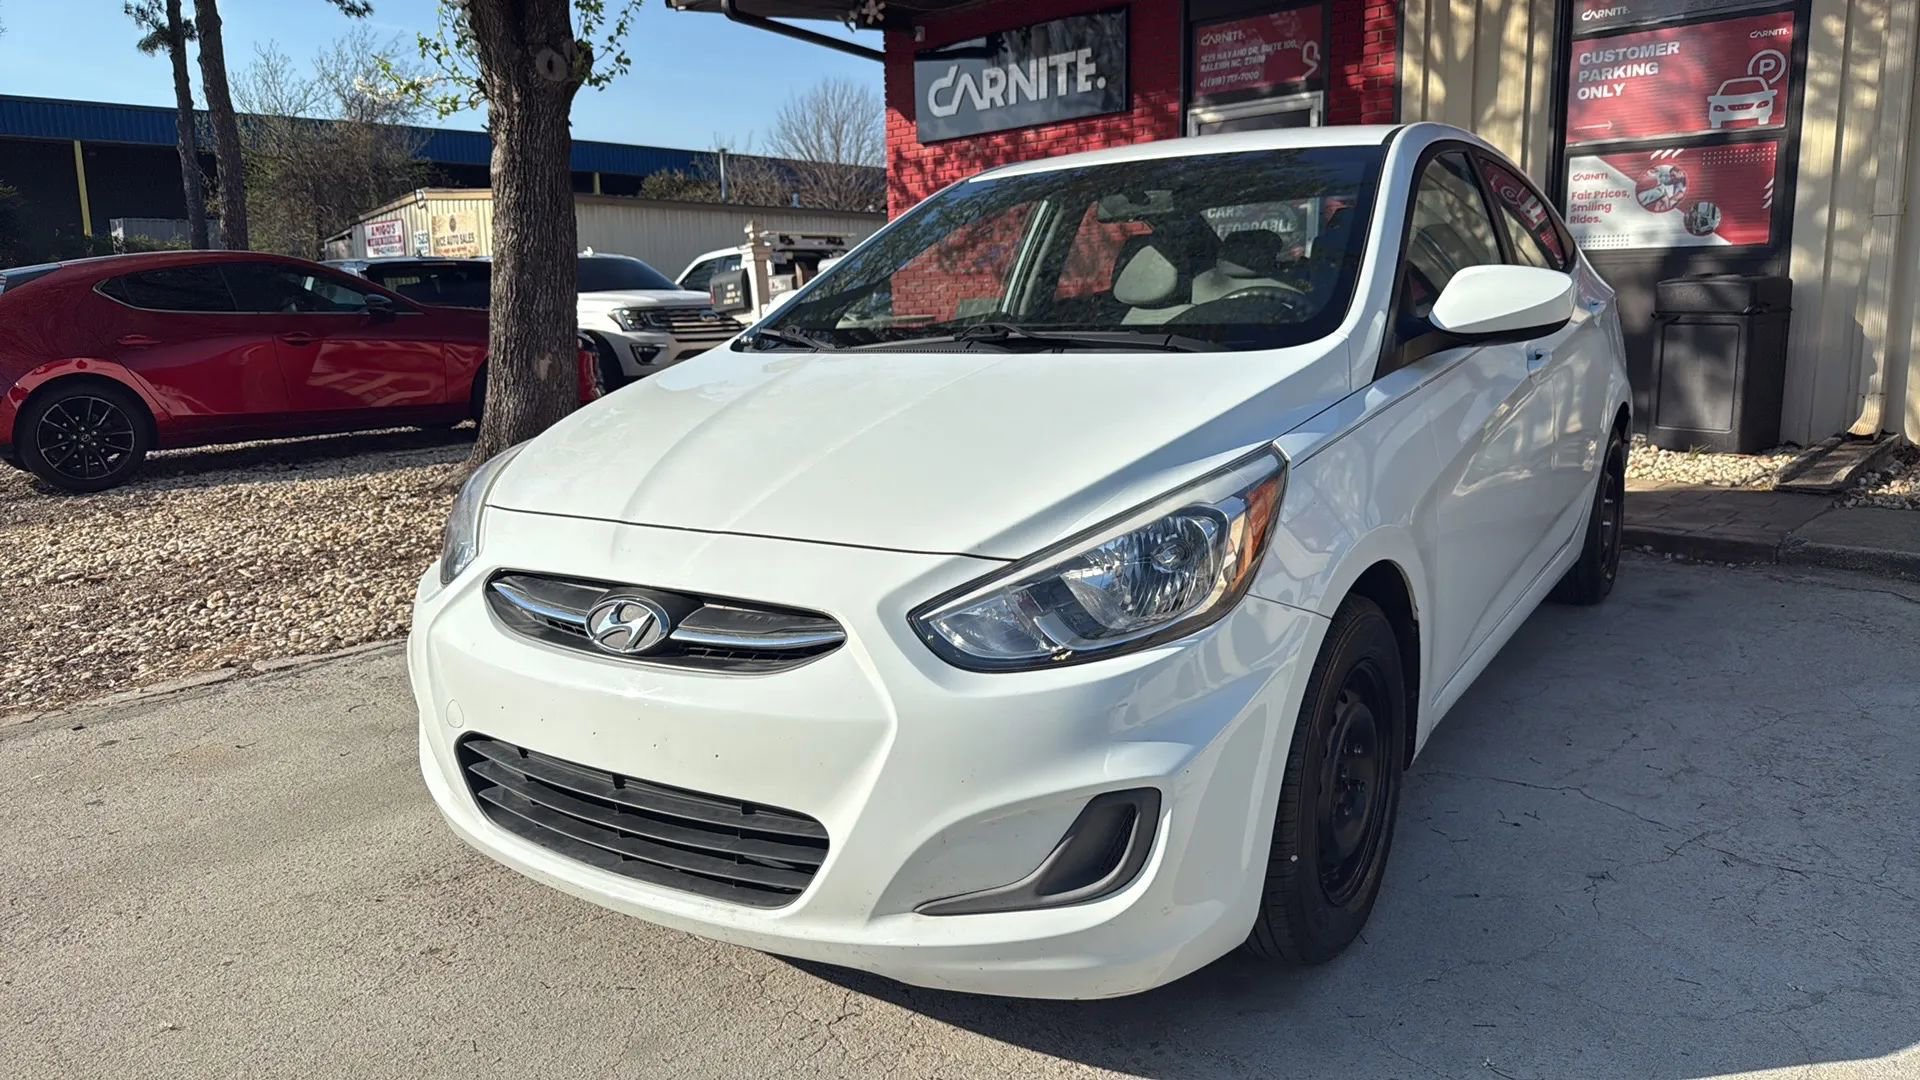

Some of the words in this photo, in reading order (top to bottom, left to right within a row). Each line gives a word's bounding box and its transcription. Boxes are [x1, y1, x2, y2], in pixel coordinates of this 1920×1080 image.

[1579, 41, 1680, 65] CUSTOMER
[1578, 62, 1659, 83] PARKING
[1577, 83, 1626, 100] ONLY
[1571, 190, 1592, 200] Fair
[1594, 189, 1631, 199] Prices,
[1570, 201, 1612, 213] Smiling
[1569, 214, 1602, 224] Rides.
[371, 223, 396, 236] AMIGO'S
[460, 232, 475, 244] SALES
